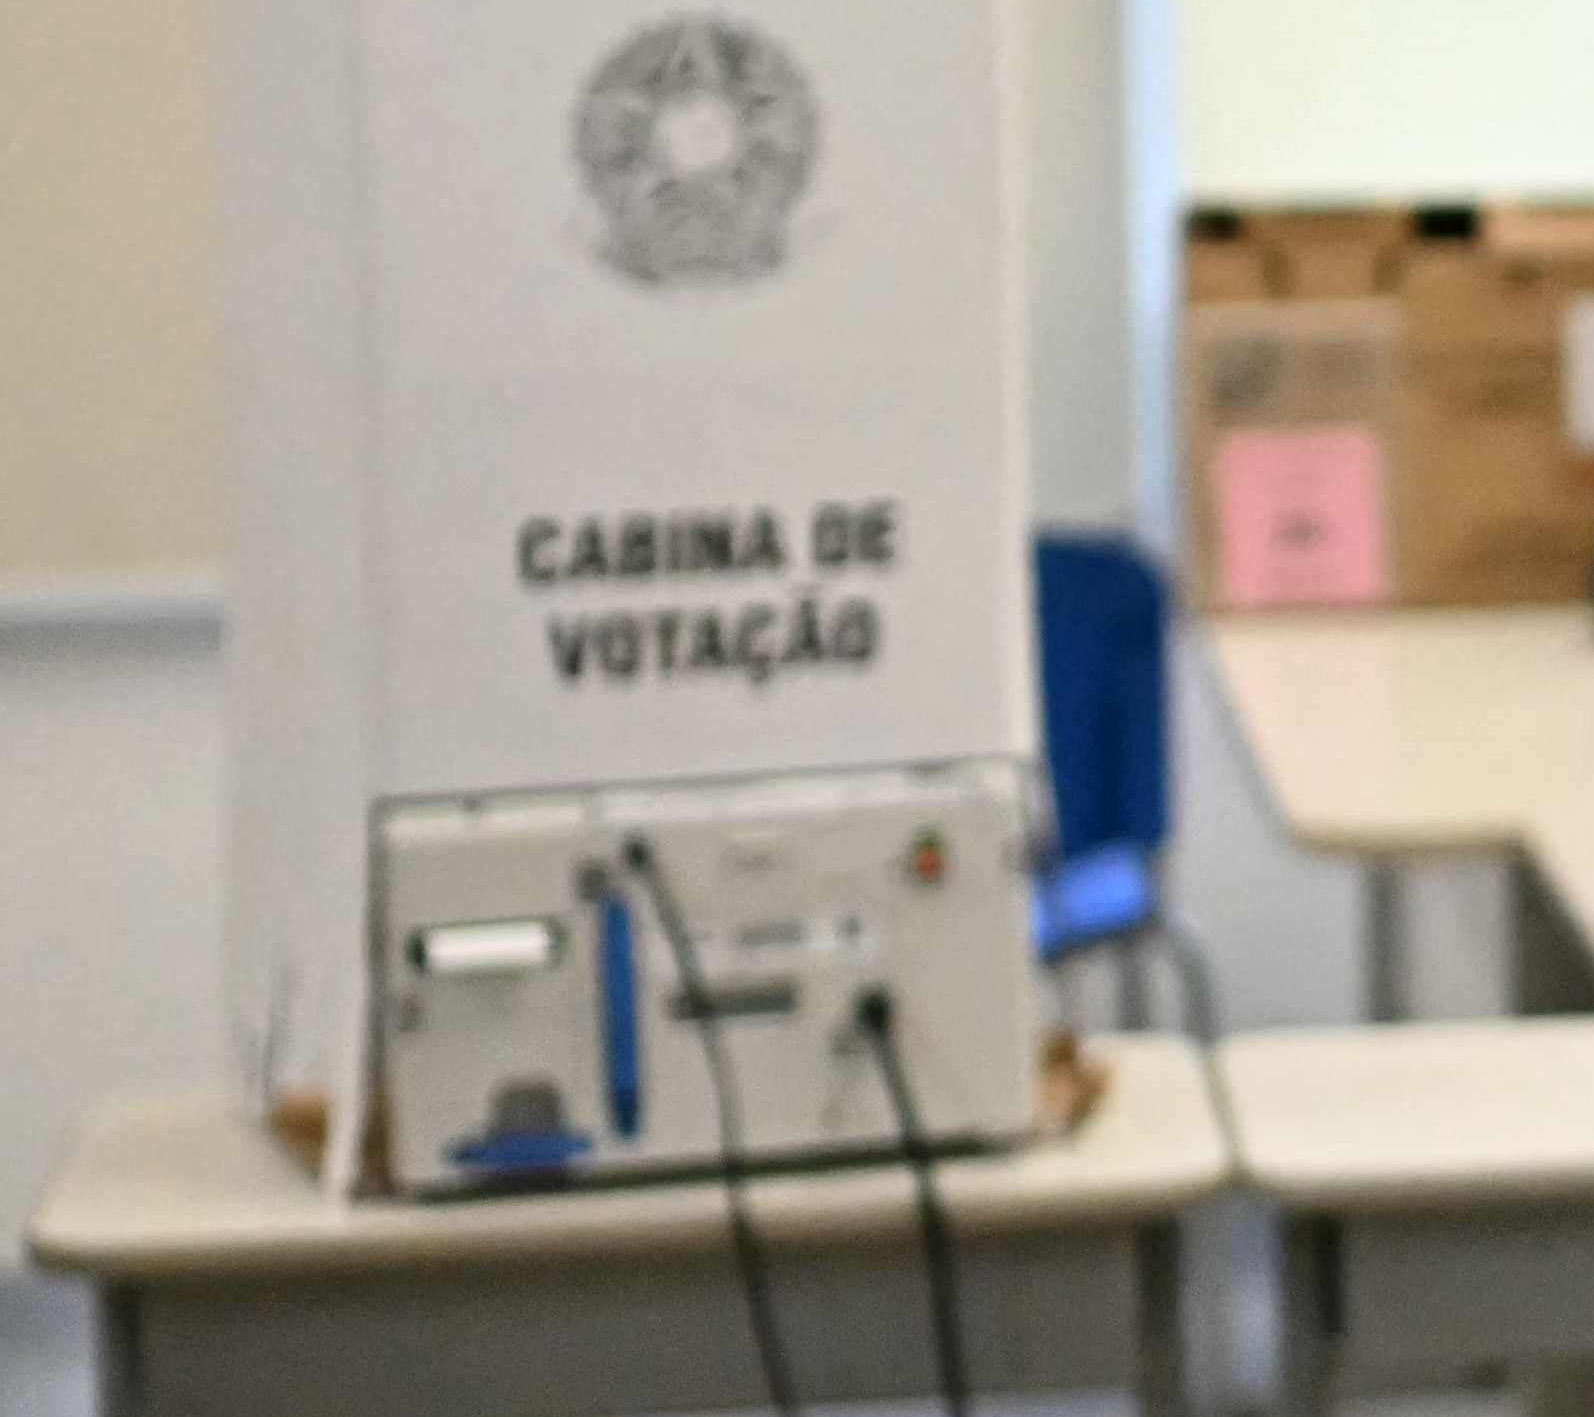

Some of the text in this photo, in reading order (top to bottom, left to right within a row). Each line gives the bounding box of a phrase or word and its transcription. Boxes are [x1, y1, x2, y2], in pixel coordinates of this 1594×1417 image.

[516, 497, 899, 585] CABINA DE
[546, 589, 878, 687] VOTAÇÃO
